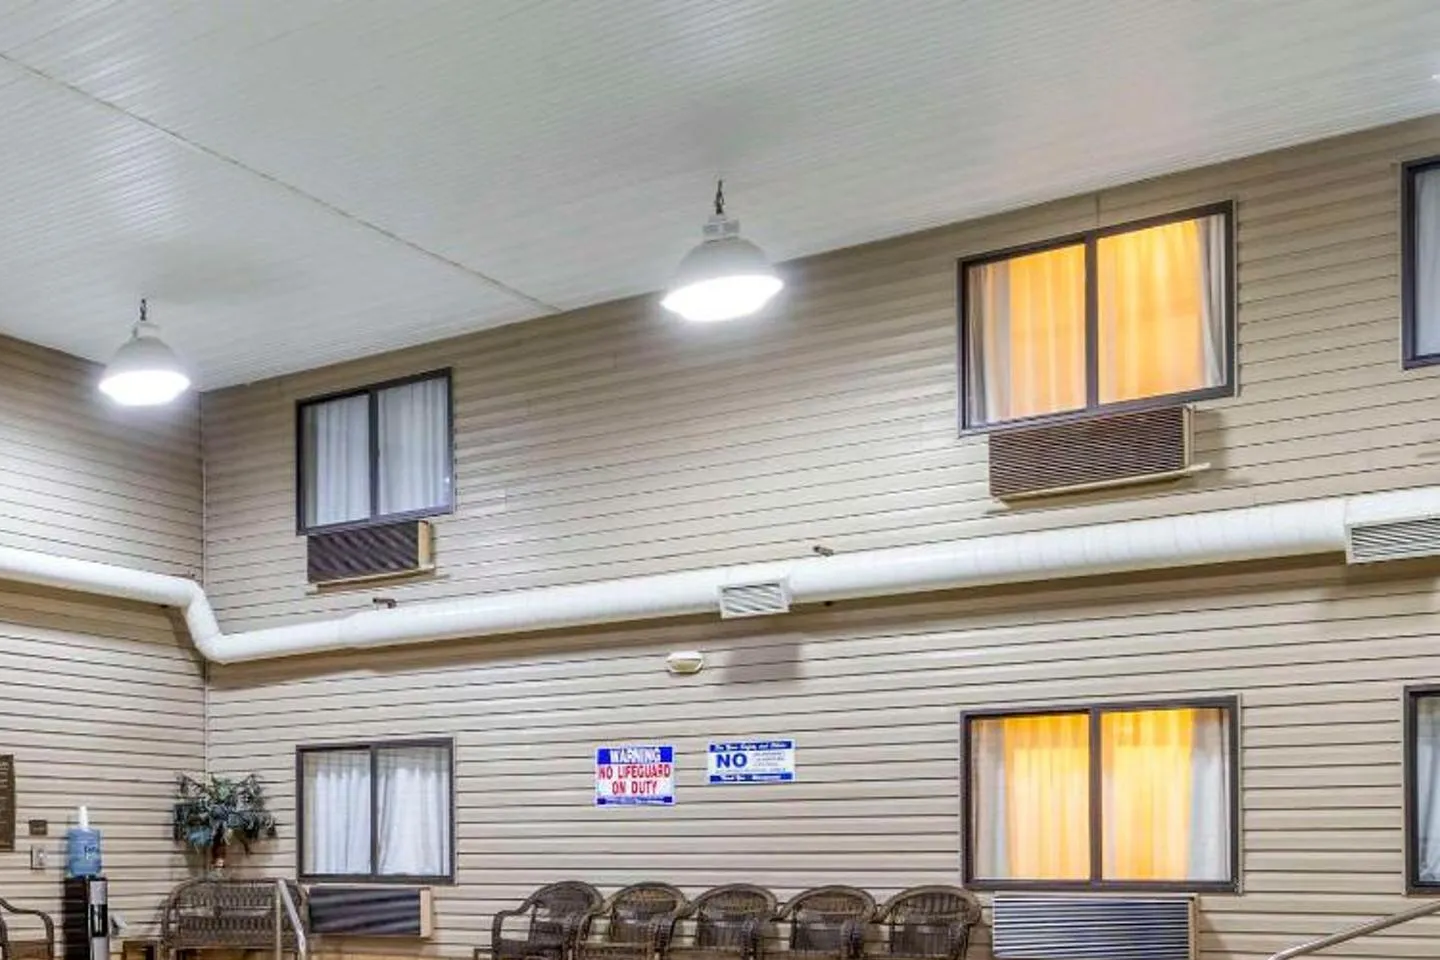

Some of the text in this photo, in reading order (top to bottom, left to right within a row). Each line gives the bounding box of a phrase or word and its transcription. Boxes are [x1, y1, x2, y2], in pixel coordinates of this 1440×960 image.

[610, 748, 661, 764] WARNING
[716, 753, 747, 768] NO
[599, 764, 671, 779] NO LIFEGUARD
[612, 780, 658, 795] ON DUTY
